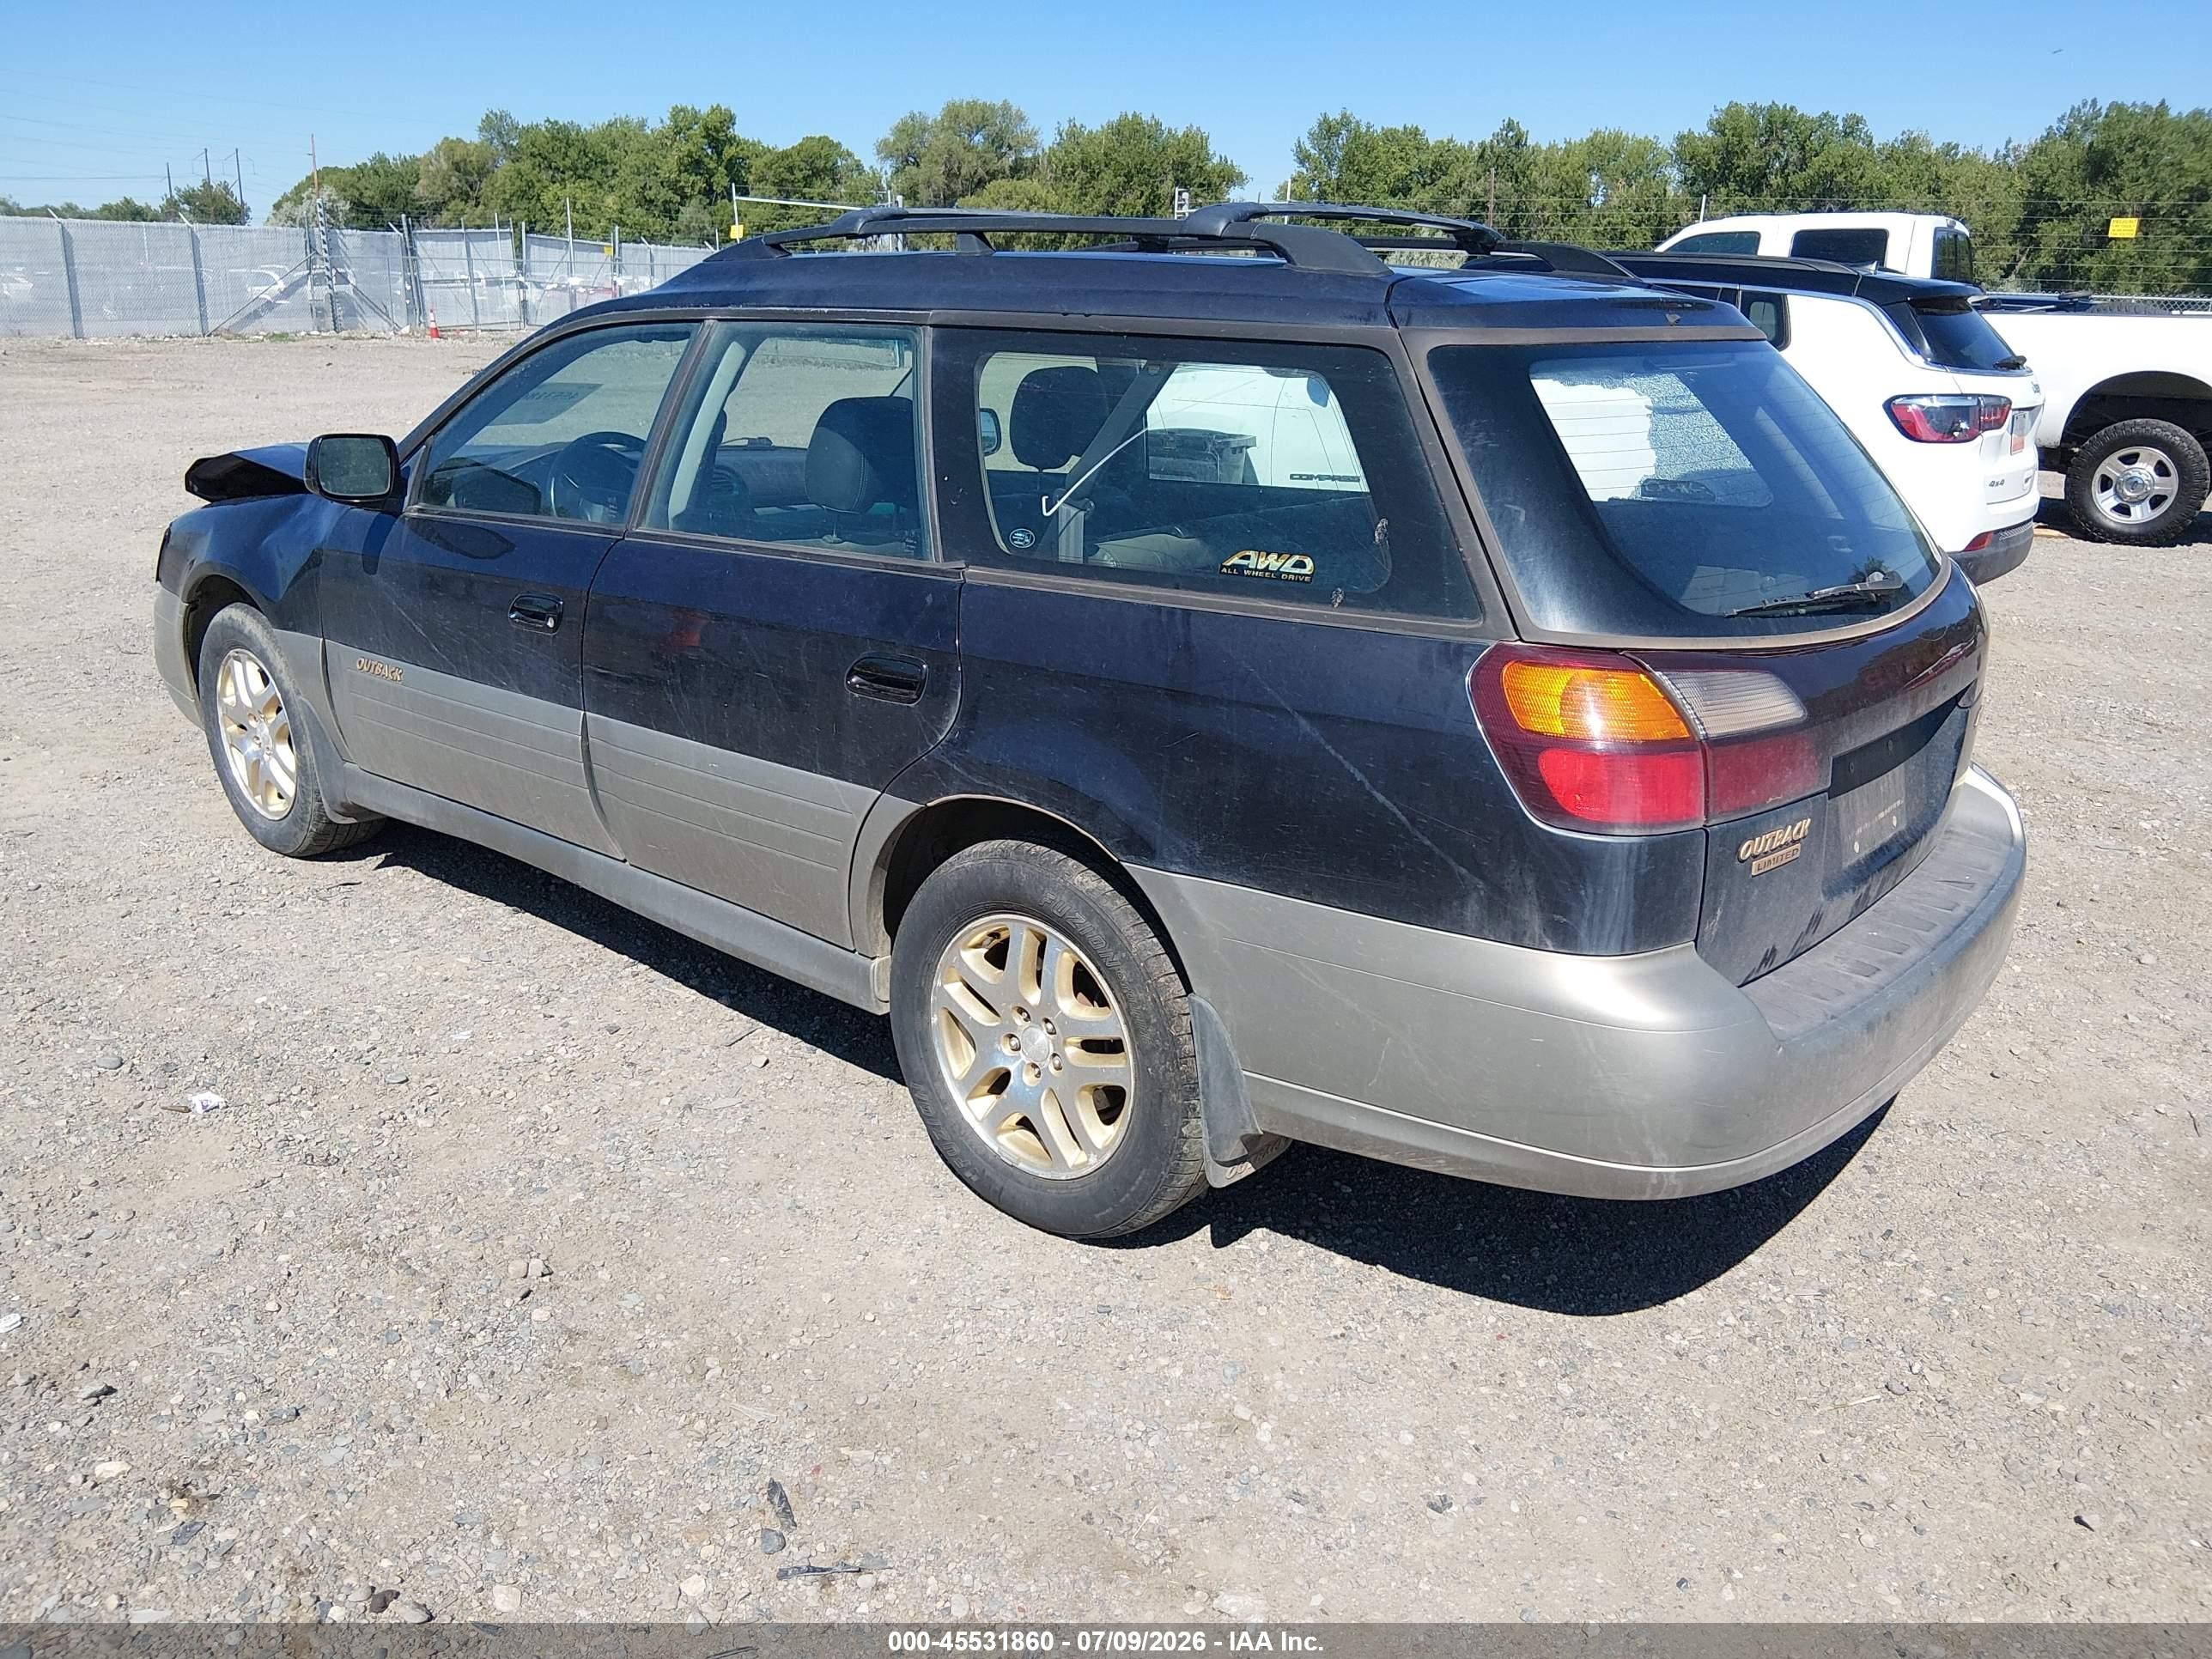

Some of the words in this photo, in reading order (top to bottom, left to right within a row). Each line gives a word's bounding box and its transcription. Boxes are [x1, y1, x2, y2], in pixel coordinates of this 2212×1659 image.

[1222, 550, 1315, 574] AWD
[1243, 569, 1278, 579] WHEEL
[1281, 573, 1312, 582] DRIVE
[356, 656, 404, 682] OUTBACK
[1738, 817, 1811, 862] OUTBACK
[1756, 847, 1800, 872] LIMITED
[1037, 891, 1121, 969] FUZION
